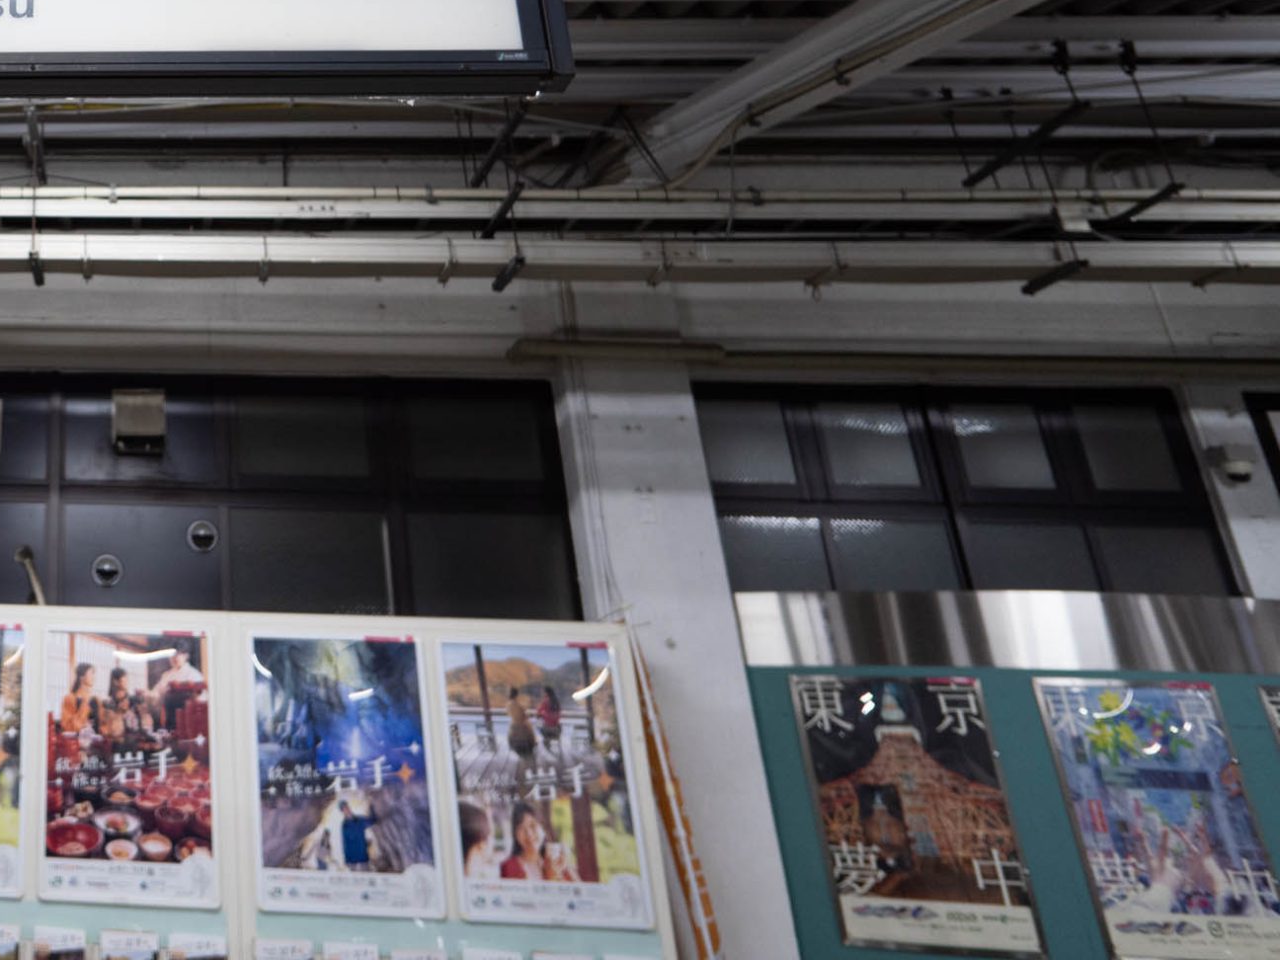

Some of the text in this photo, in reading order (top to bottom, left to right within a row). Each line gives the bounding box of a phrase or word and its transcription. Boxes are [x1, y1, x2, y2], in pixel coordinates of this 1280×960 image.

[110, 747, 178, 783] 岩手
[325, 755, 393, 791] 岩手
[524, 763, 593, 800] 岩手
